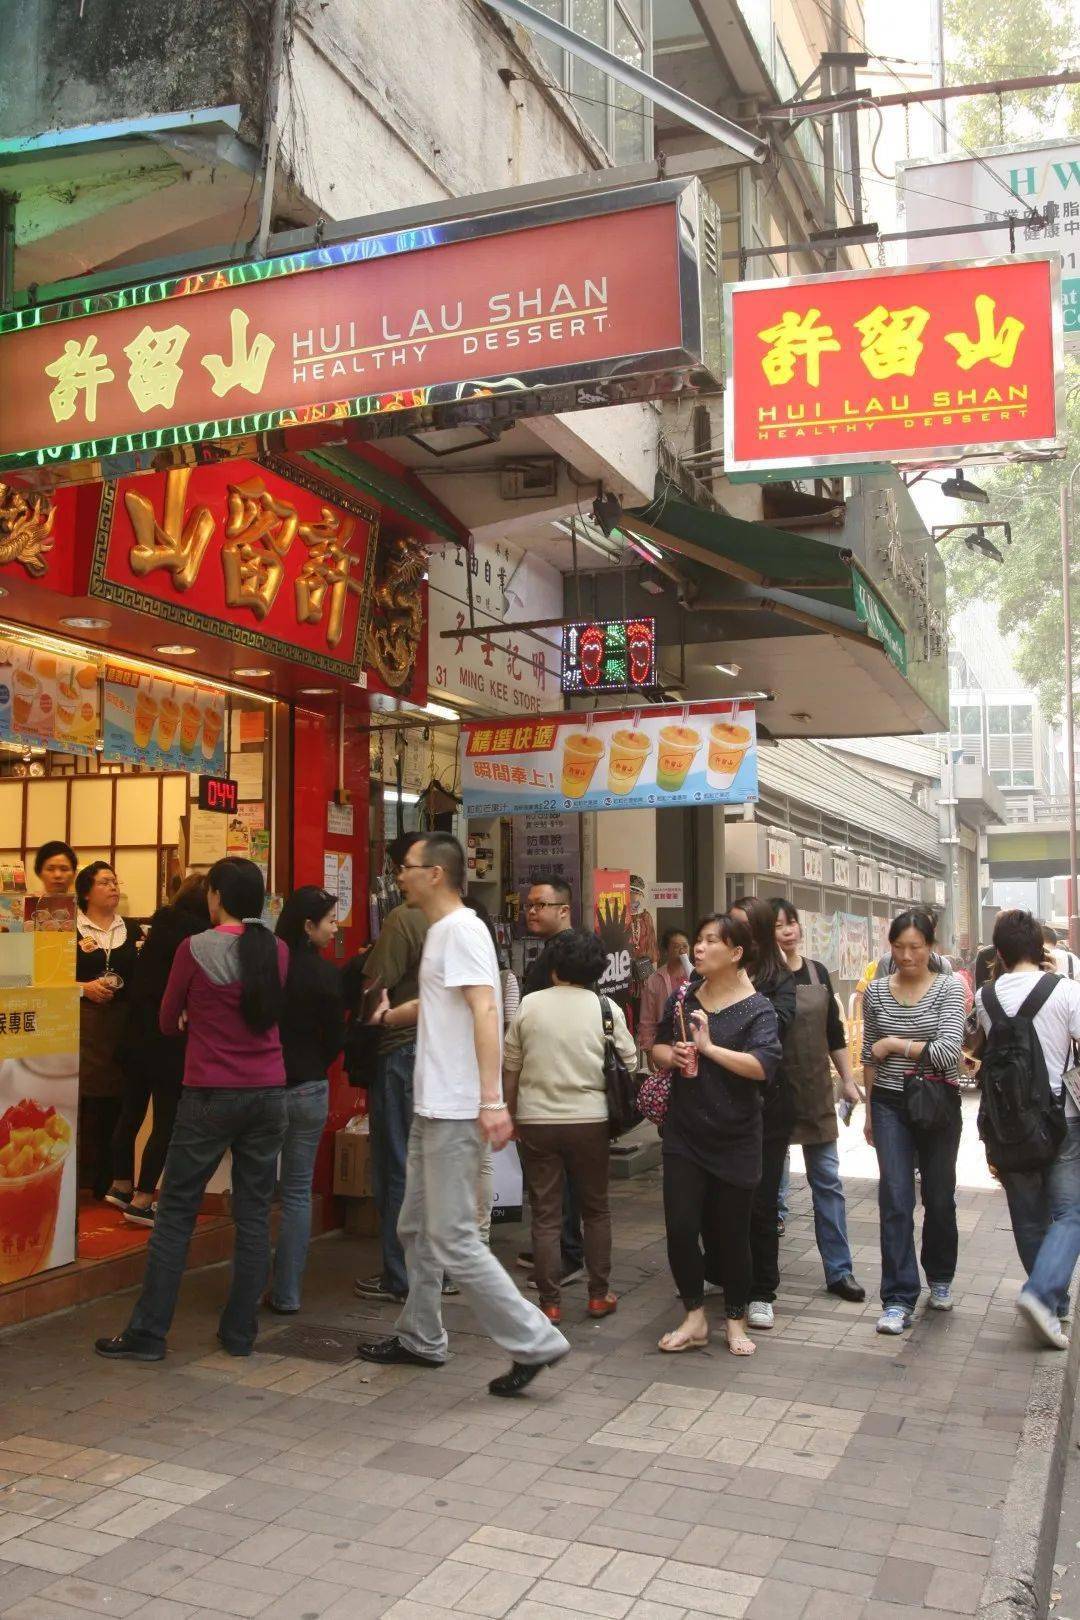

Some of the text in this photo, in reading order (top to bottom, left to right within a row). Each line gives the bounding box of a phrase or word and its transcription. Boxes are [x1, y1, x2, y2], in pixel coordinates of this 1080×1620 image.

[292, 277, 608, 357] HUI LAU SHAN
[757, 294, 1025, 388] 許留山
[45, 308, 276, 422] 許留山
[292, 315, 608, 384] HEALTHY DESSERT
[758, 384, 1028, 422] HUI LAU SHAN
[758, 410, 1028, 440] HEALTHY DESSERT
[436, 665, 541, 713] 31 MING KEE STORE
[208, 780, 235, 810] 044
